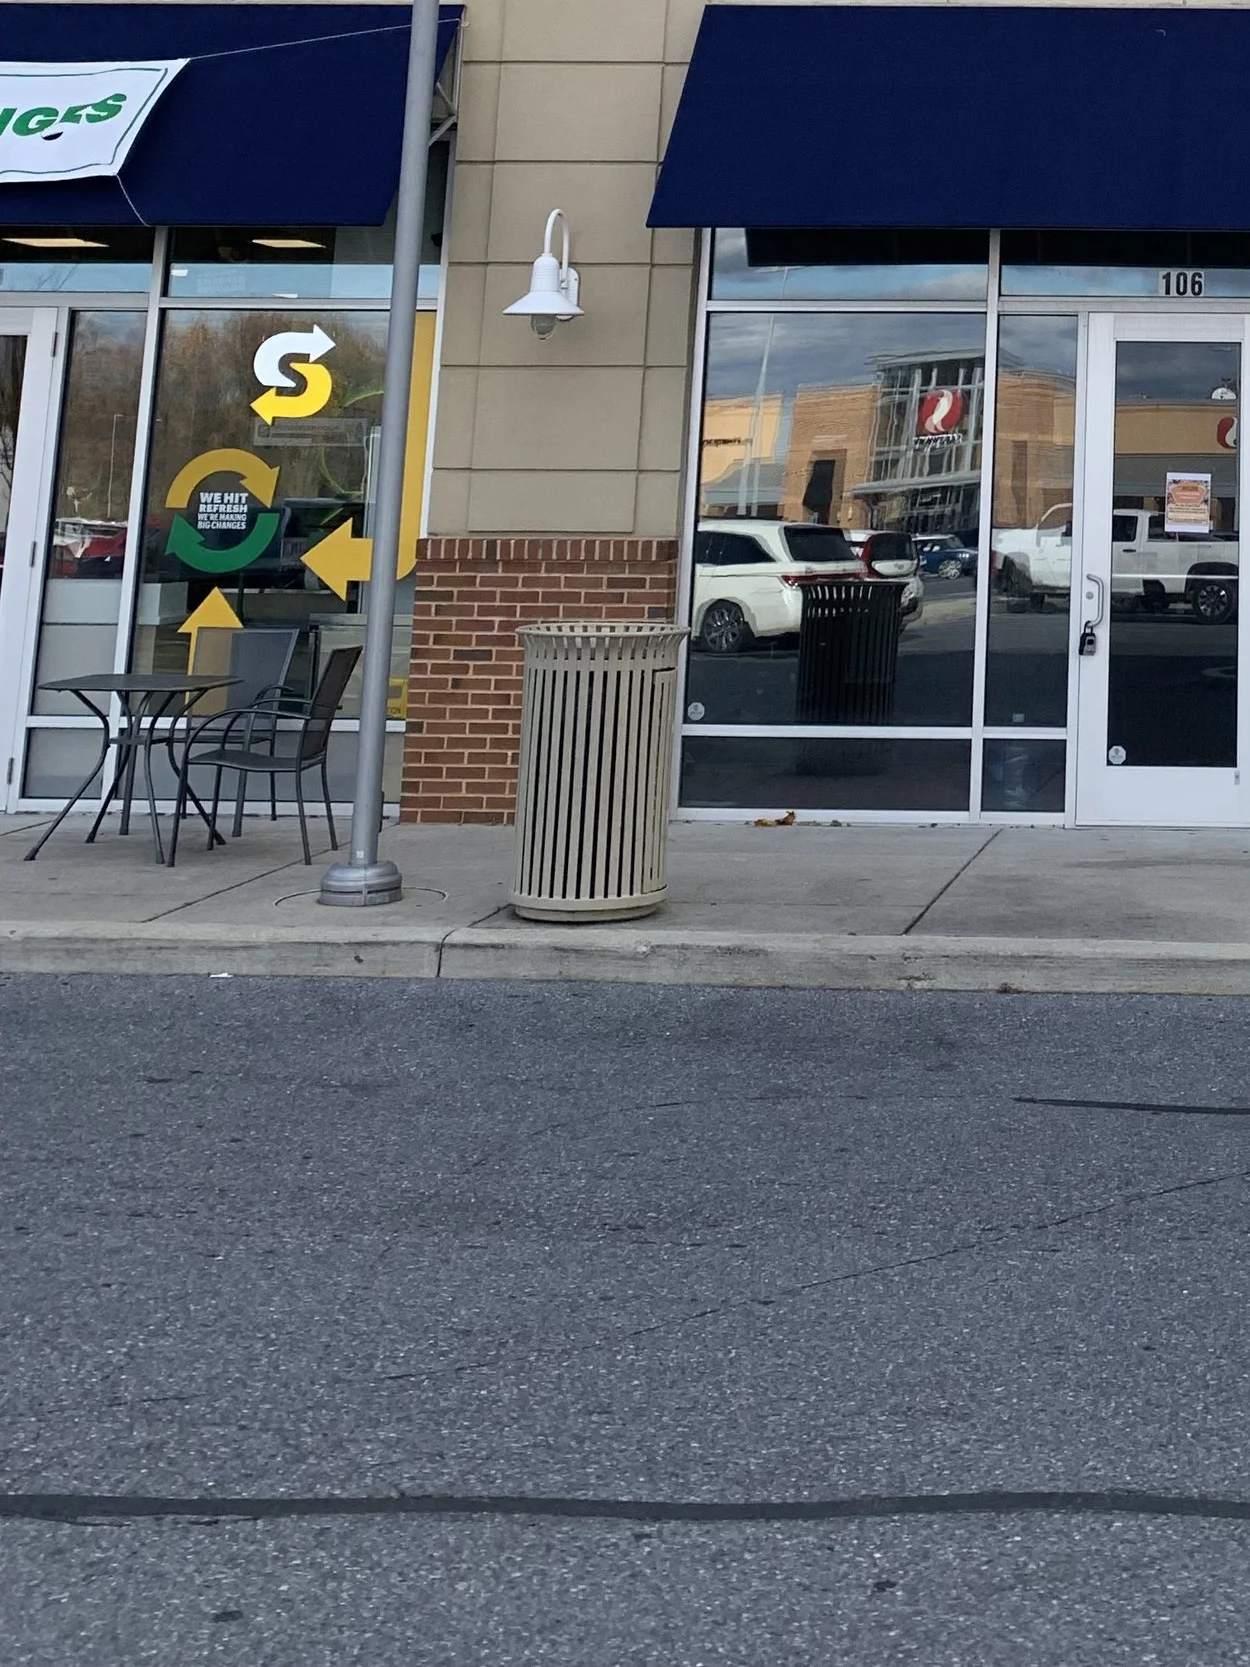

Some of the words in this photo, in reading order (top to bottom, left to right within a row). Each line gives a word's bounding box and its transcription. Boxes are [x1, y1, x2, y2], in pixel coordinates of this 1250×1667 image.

[0, 93, 127, 137] GES
[1162, 272, 1203, 296] 106
[200, 492, 222, 504] WE
[223, 492, 248, 504] HIT
[199, 504, 248, 513] REFRESH
[219, 513, 247, 522] MAKING
[197, 521, 211, 530] BIG
[211, 521, 246, 530] CHANGES
